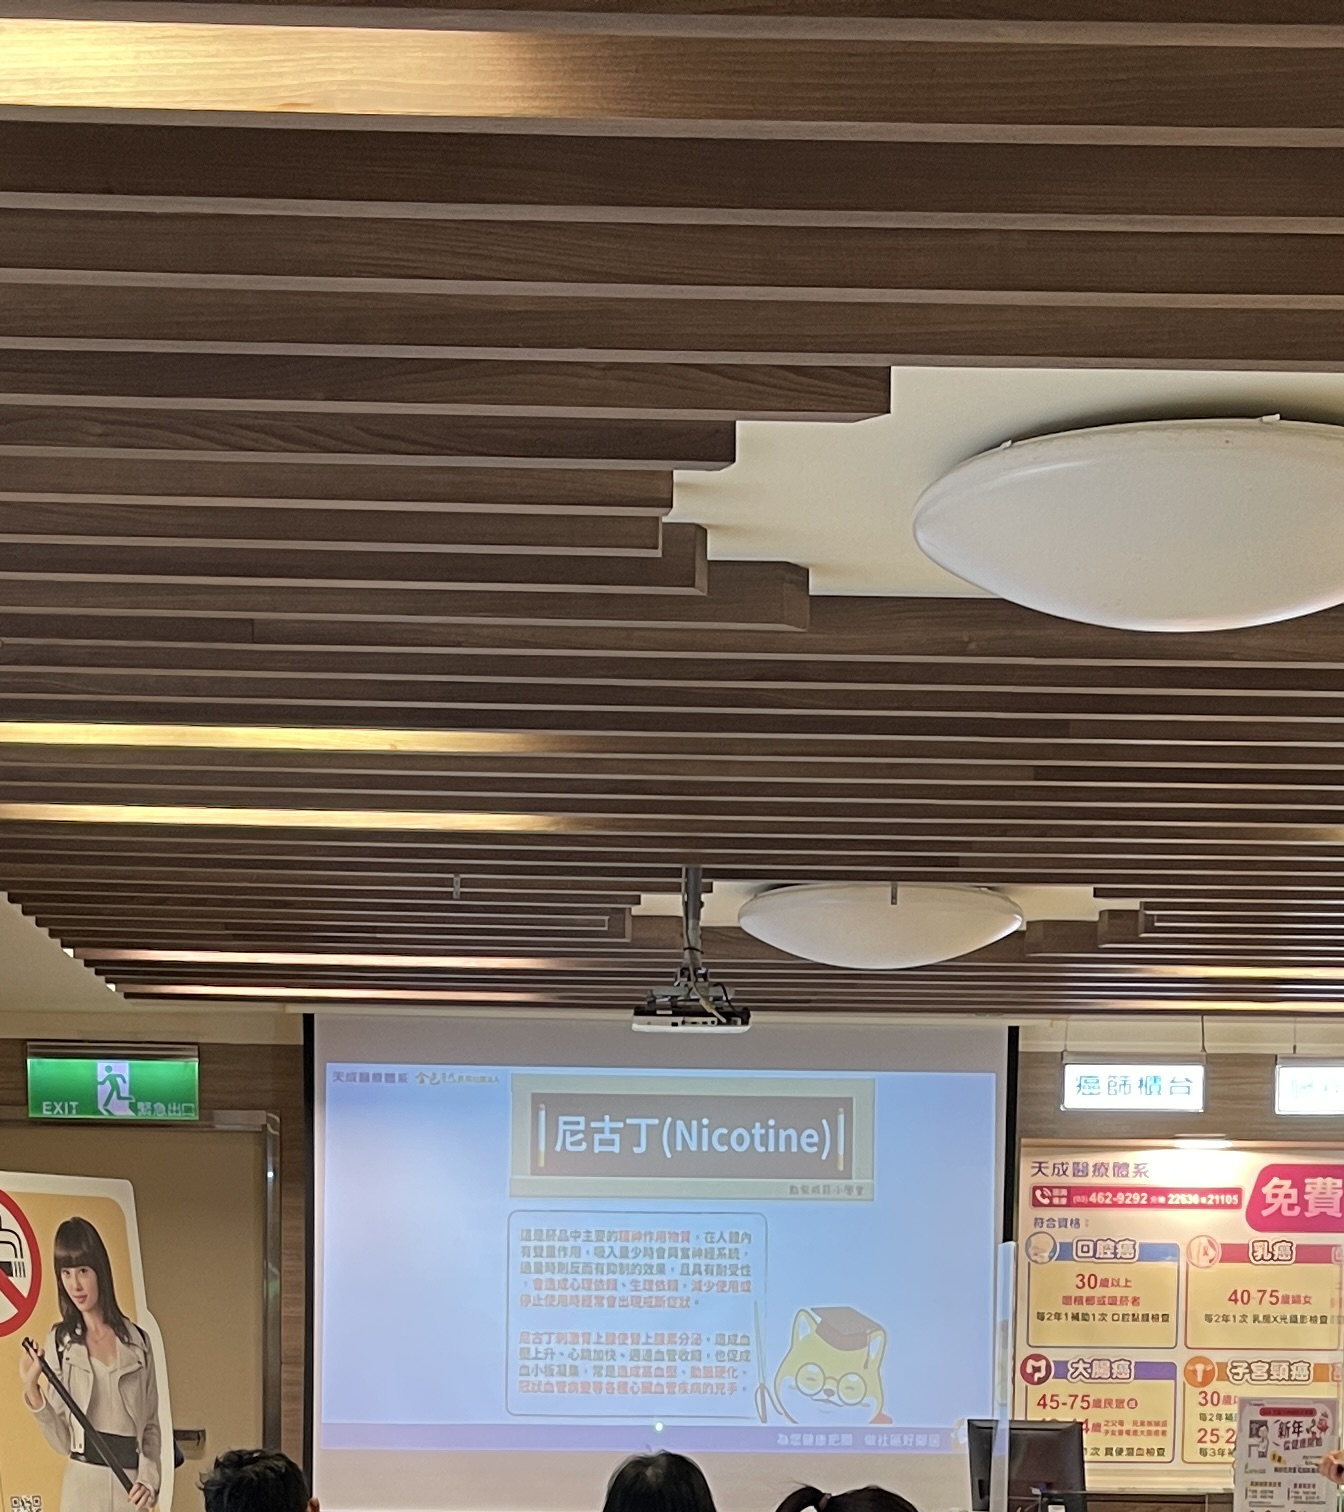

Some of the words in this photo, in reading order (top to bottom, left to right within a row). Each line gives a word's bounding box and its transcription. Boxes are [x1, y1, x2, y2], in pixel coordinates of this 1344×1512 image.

[1074, 1074, 1194, 1097] 癌篩櫃台
[42, 1101, 79, 1115] EXIT
[554, 1113, 832, 1161] 尼古丁(Nicotine)
[1029, 1160, 1150, 1179] 天成醫療體系
[1259, 1176, 1344, 1218] 免費
[1074, 1237, 1138, 1261] 口腔癌
[1250, 1239, 1295, 1262] 乳癌
[1075, 1272, 1133, 1291] 30歲以上
[1071, 1357, 1132, 1381] 大腸癌
[1229, 1359, 1311, 1382] 子宮頸癌
